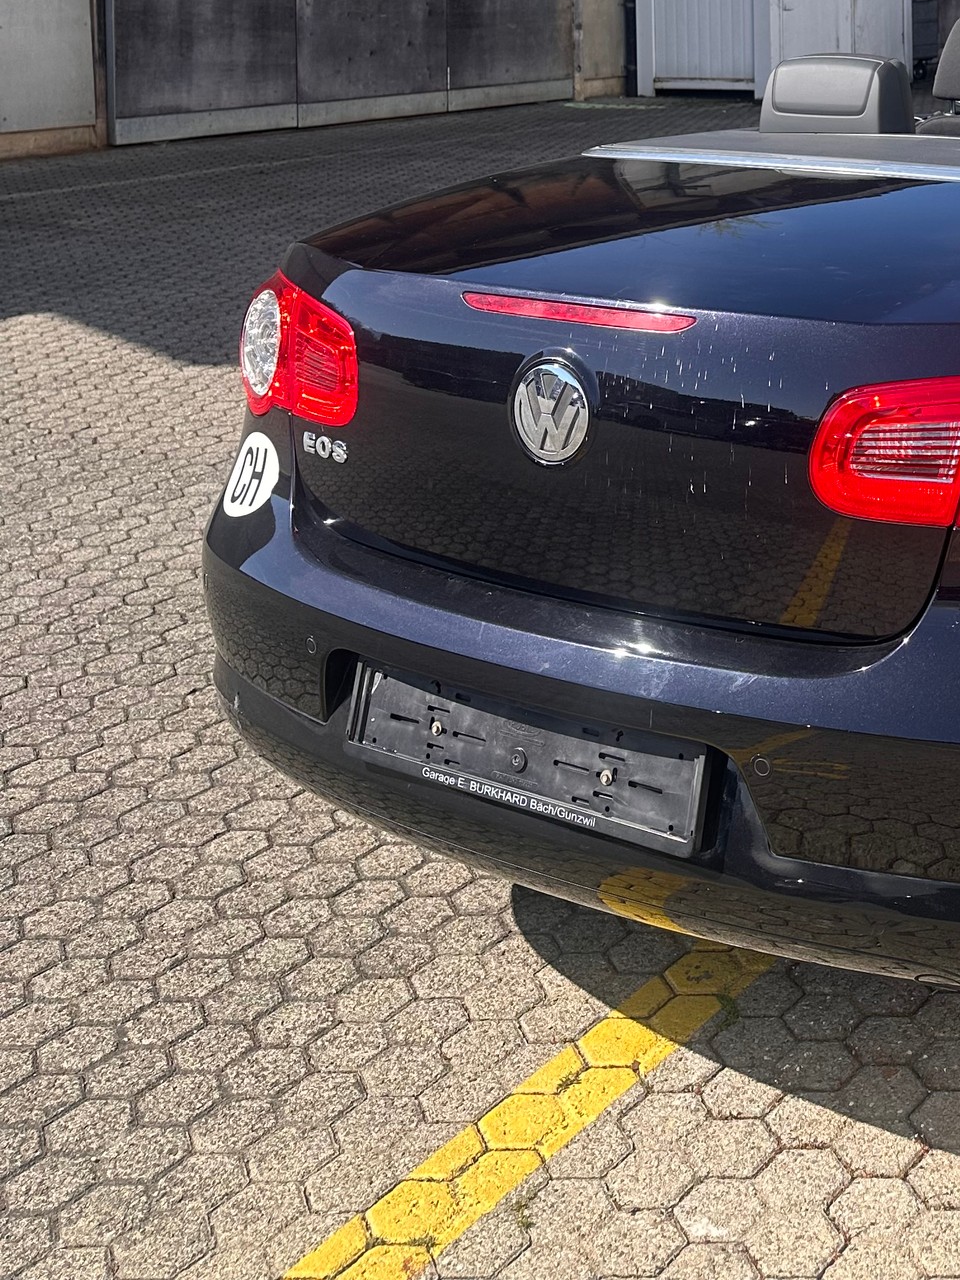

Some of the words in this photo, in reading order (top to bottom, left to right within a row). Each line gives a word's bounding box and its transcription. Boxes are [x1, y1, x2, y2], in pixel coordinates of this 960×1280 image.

[514, 363, 589, 462] VW
[303, 431, 348, 464] EOS
[230, 446, 268, 507] CH
[421, 766, 456, 786] Garage
[469, 780, 528, 808] BURKHARD
